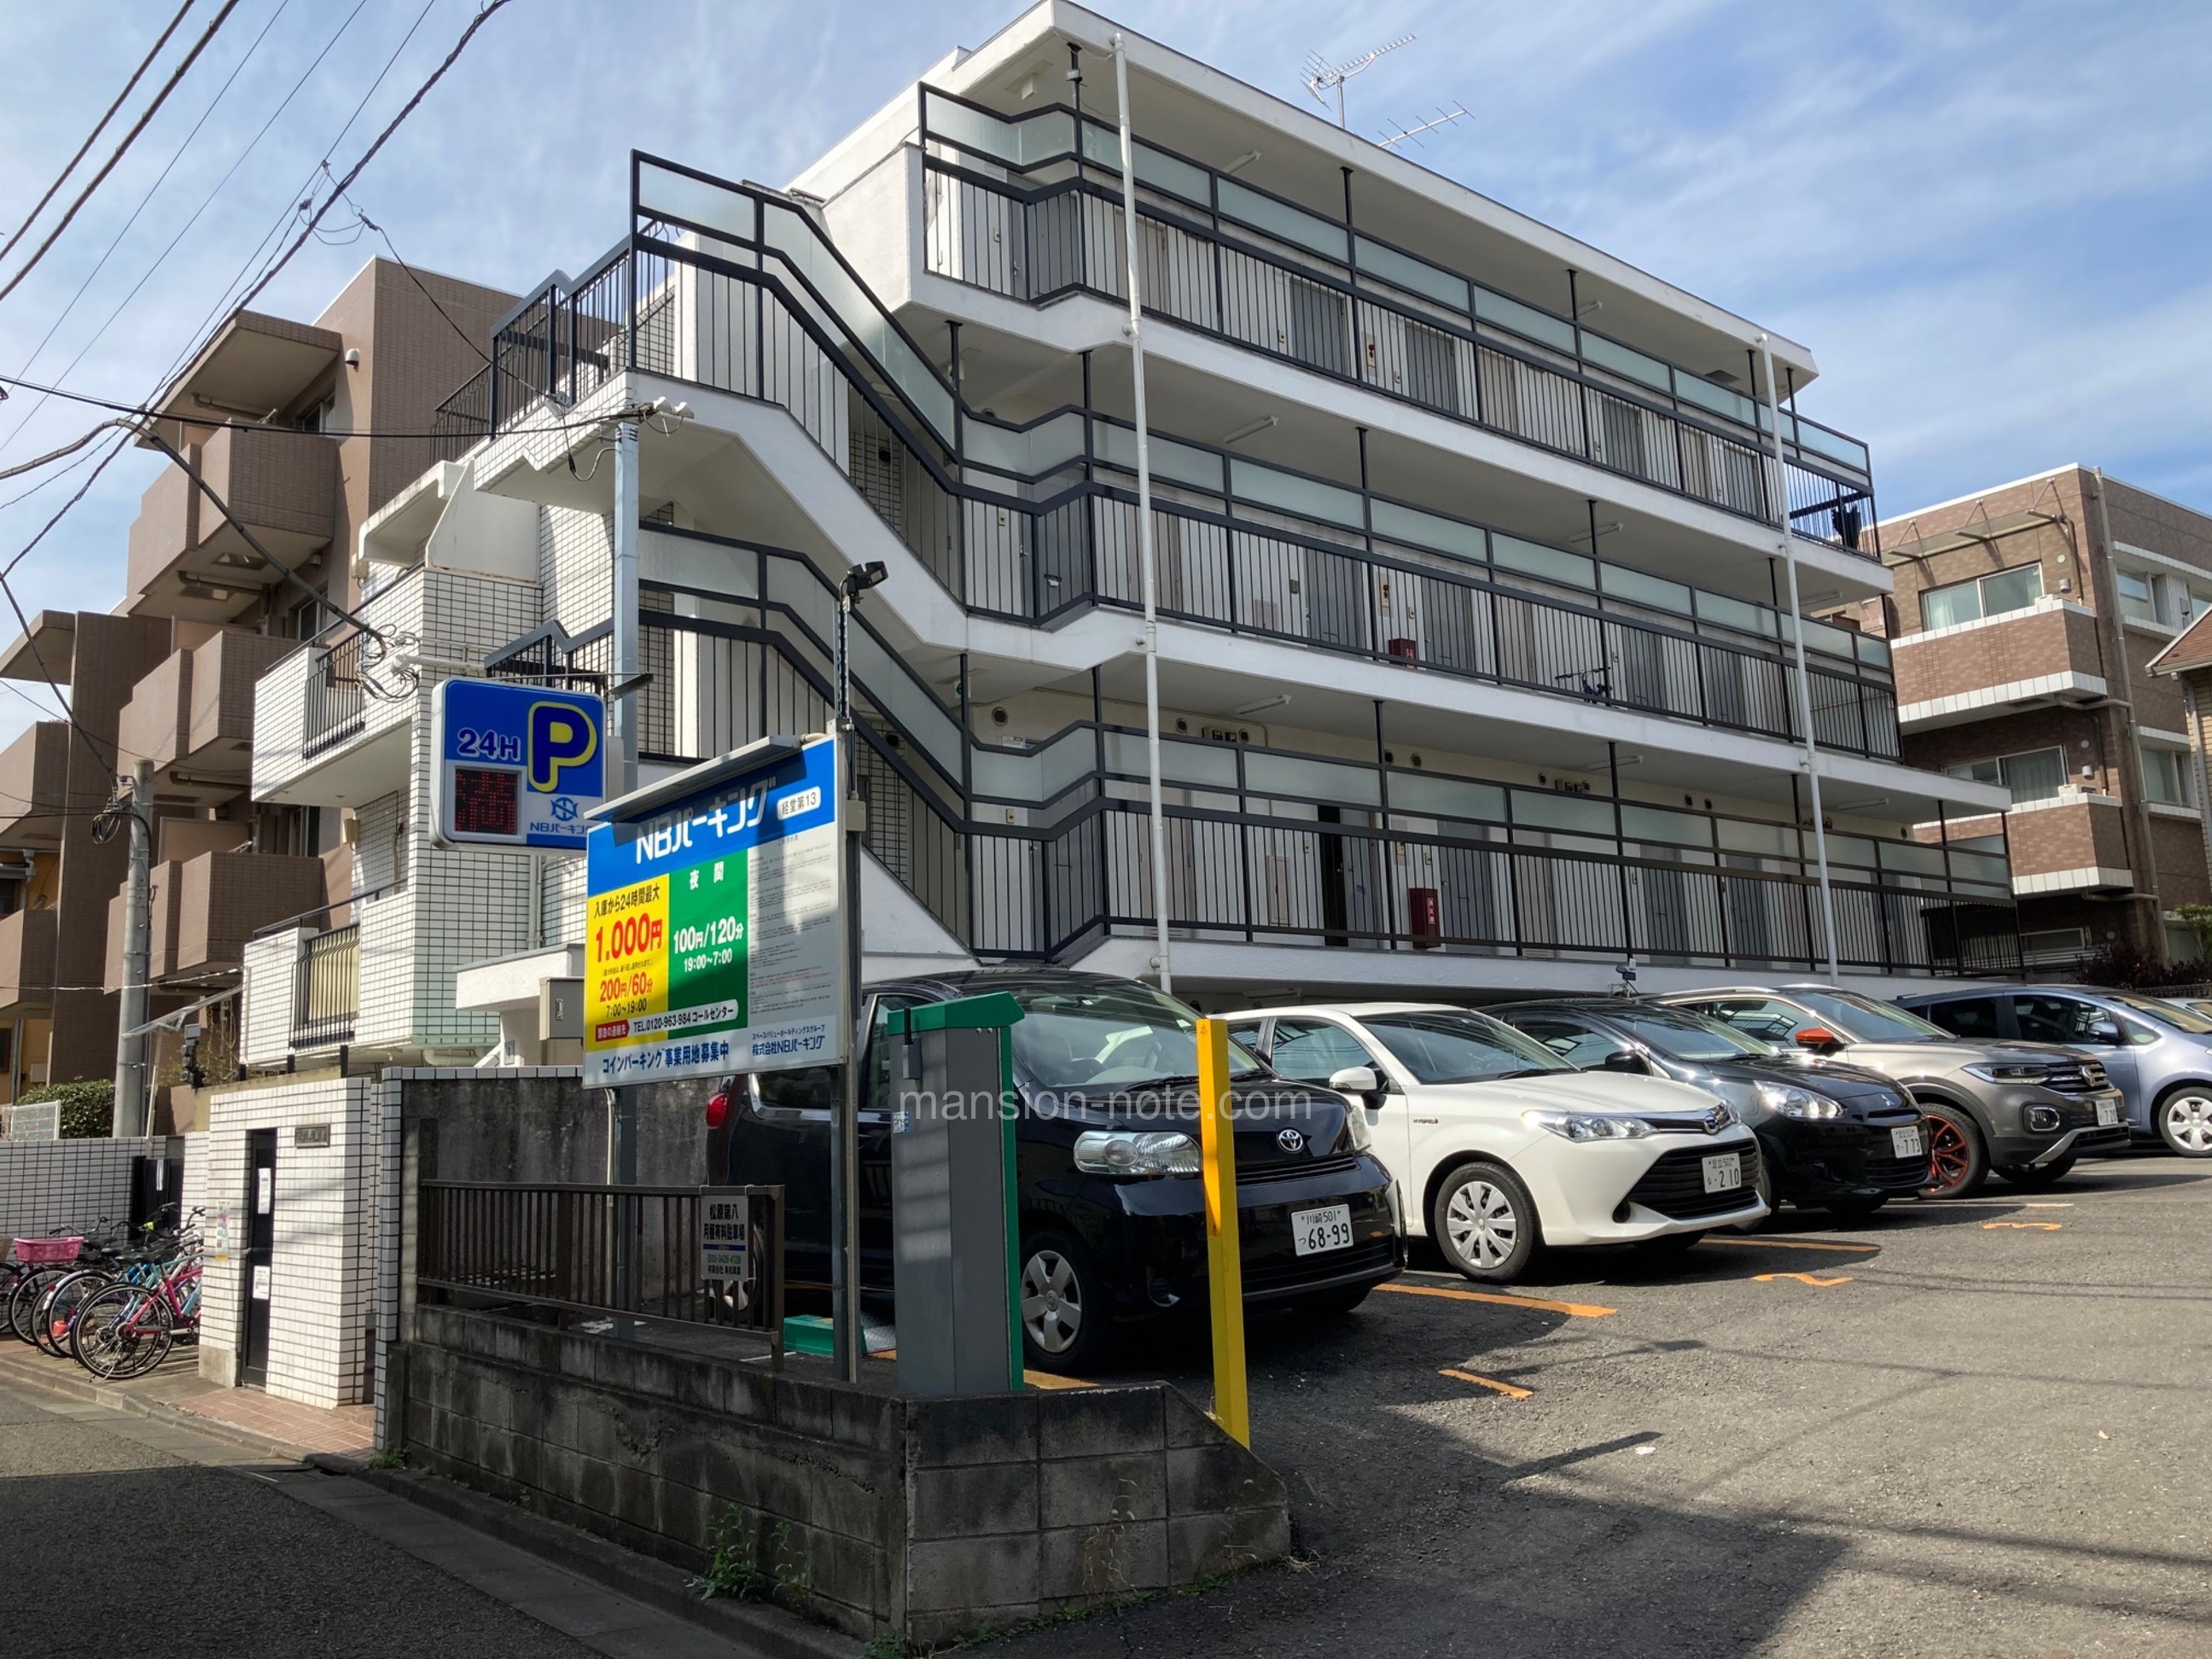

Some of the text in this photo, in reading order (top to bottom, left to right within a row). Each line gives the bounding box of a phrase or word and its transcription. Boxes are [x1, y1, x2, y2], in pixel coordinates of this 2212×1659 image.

[457, 727, 521, 762] 24H
[527, 701, 597, 792] P
[637, 777, 776, 864] NBパーキング
[594, 882, 661, 919] 入庫から24時間最大
[673, 916, 744, 954] 100円/120分
[599, 971, 654, 1003] 200円/60分
[692, 1004, 734, 1023] コールセンター
[752, 1035, 826, 1057] 株式会社NBパーキング
[1308, 1222, 1350, 1249] 68-99
